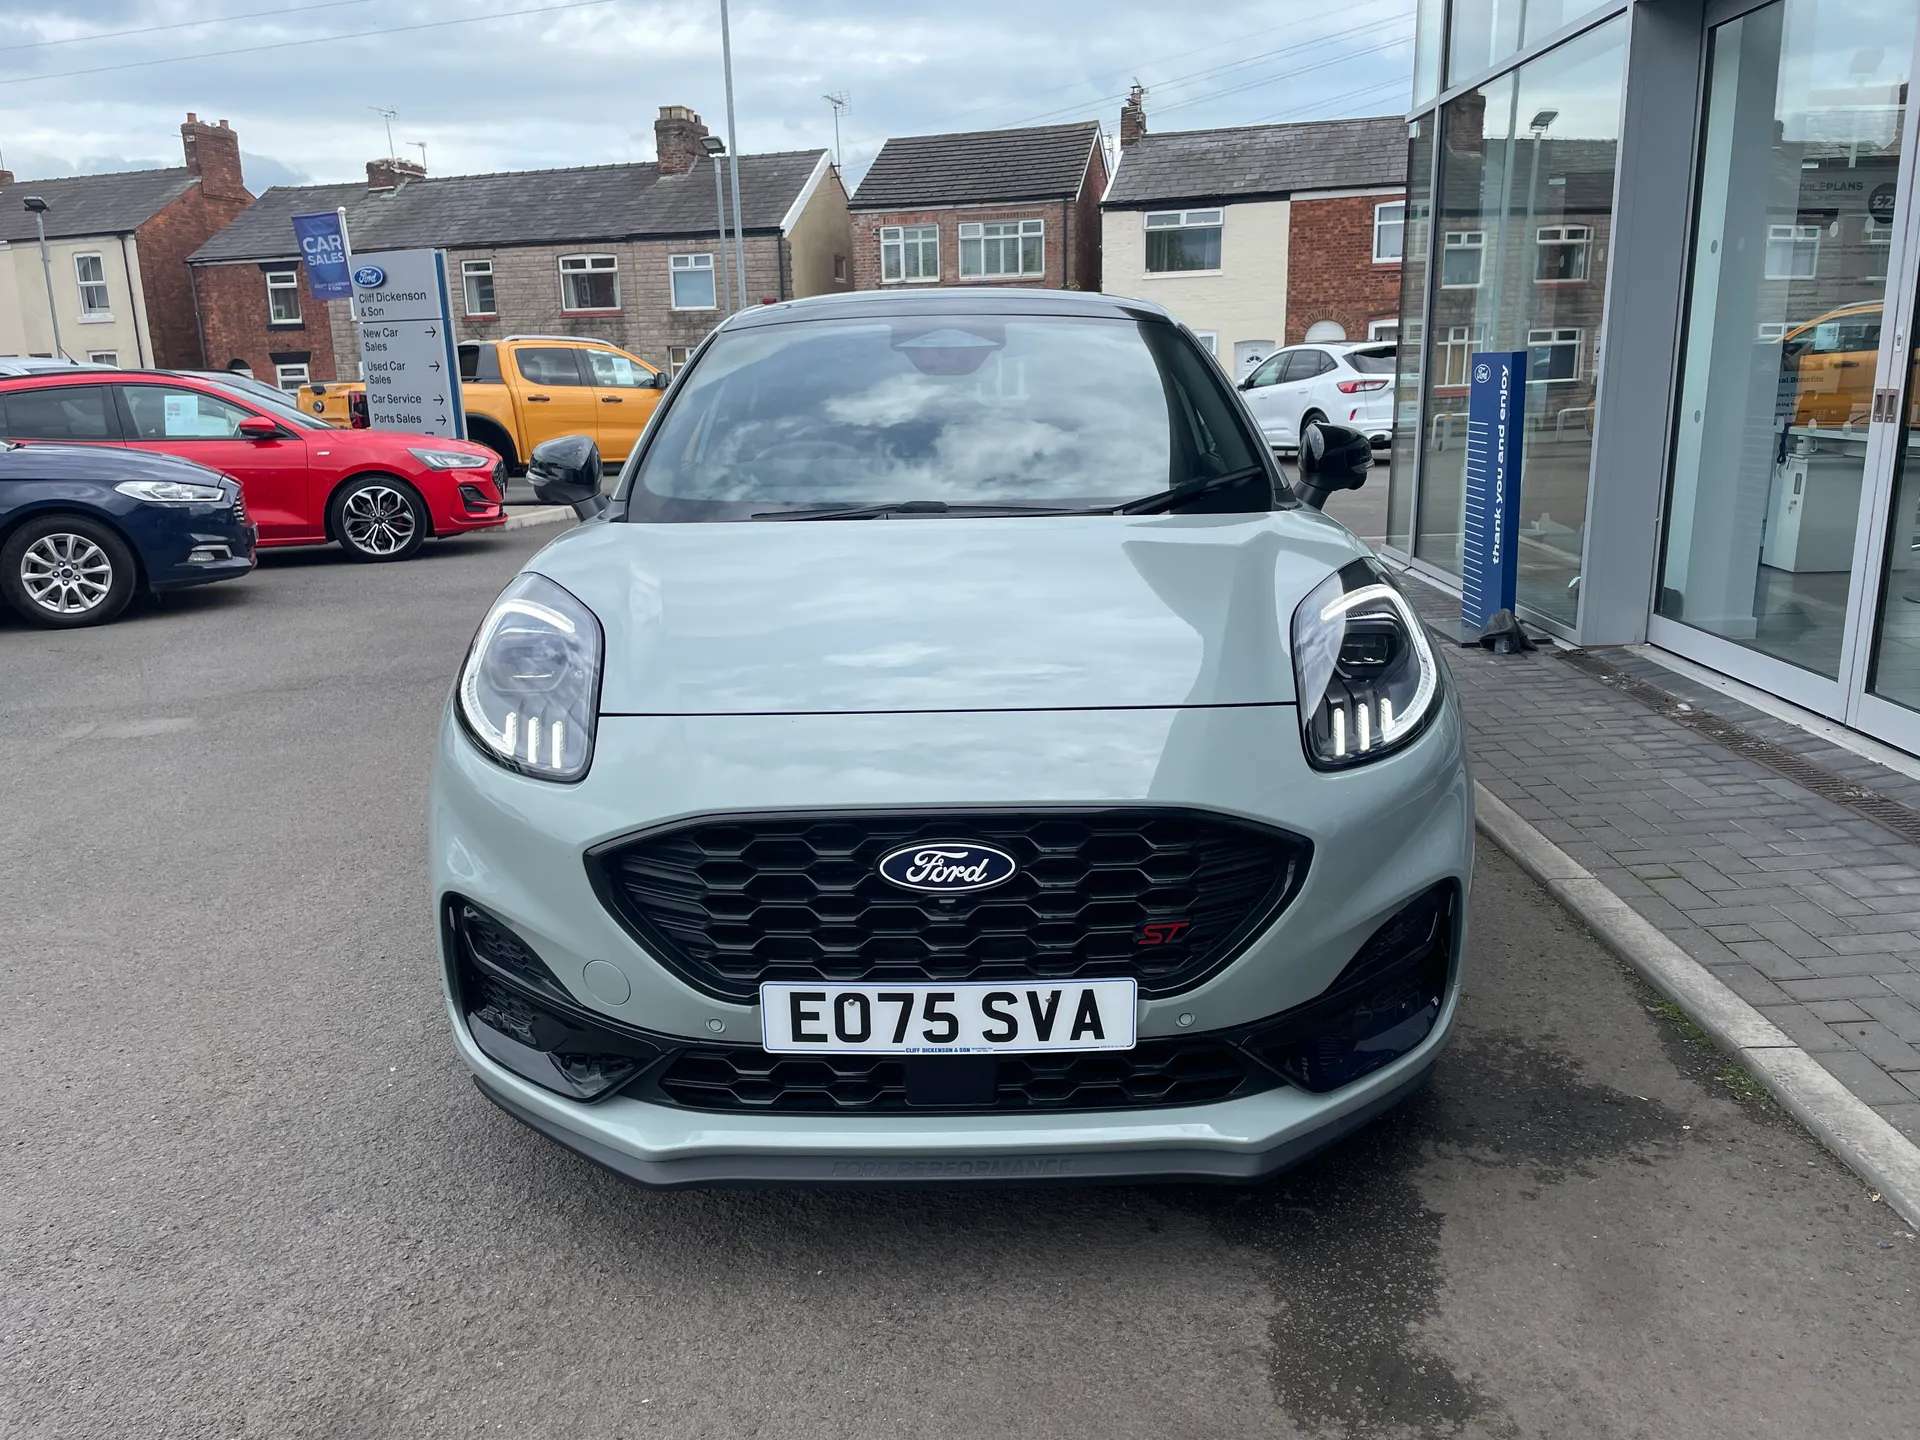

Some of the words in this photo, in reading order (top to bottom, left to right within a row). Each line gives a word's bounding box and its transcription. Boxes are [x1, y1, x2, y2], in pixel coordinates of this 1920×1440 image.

[302, 234, 343, 253] CAR
[307, 252, 345, 266] SALES
[359, 293, 374, 304] Cliff
[376, 292, 427, 302] Dickenson
[360, 307, 367, 317] &
[367, 306, 384, 317] Son
[363, 328, 380, 338] New
[382, 327, 399, 338] Car
[365, 341, 388, 352] Sales
[367, 361, 388, 371] Used
[389, 360, 405, 371] Car
[369, 374, 392, 385] Sales
[371, 393, 386, 404] Car
[387, 393, 422, 404] Service
[1499, 364, 1509, 420] enjoy
[374, 413, 395, 424] Parts
[396, 413, 422, 424] Sales
[1497, 424, 1505, 463] and
[1495, 467, 1504, 504] you
[1492, 505, 1502, 565] thank
[905, 850, 990, 883] Ford
[1137, 921, 1191, 945] ST
[789, 991, 960, 1043] EO75
[981, 988, 1106, 1043] SVA
